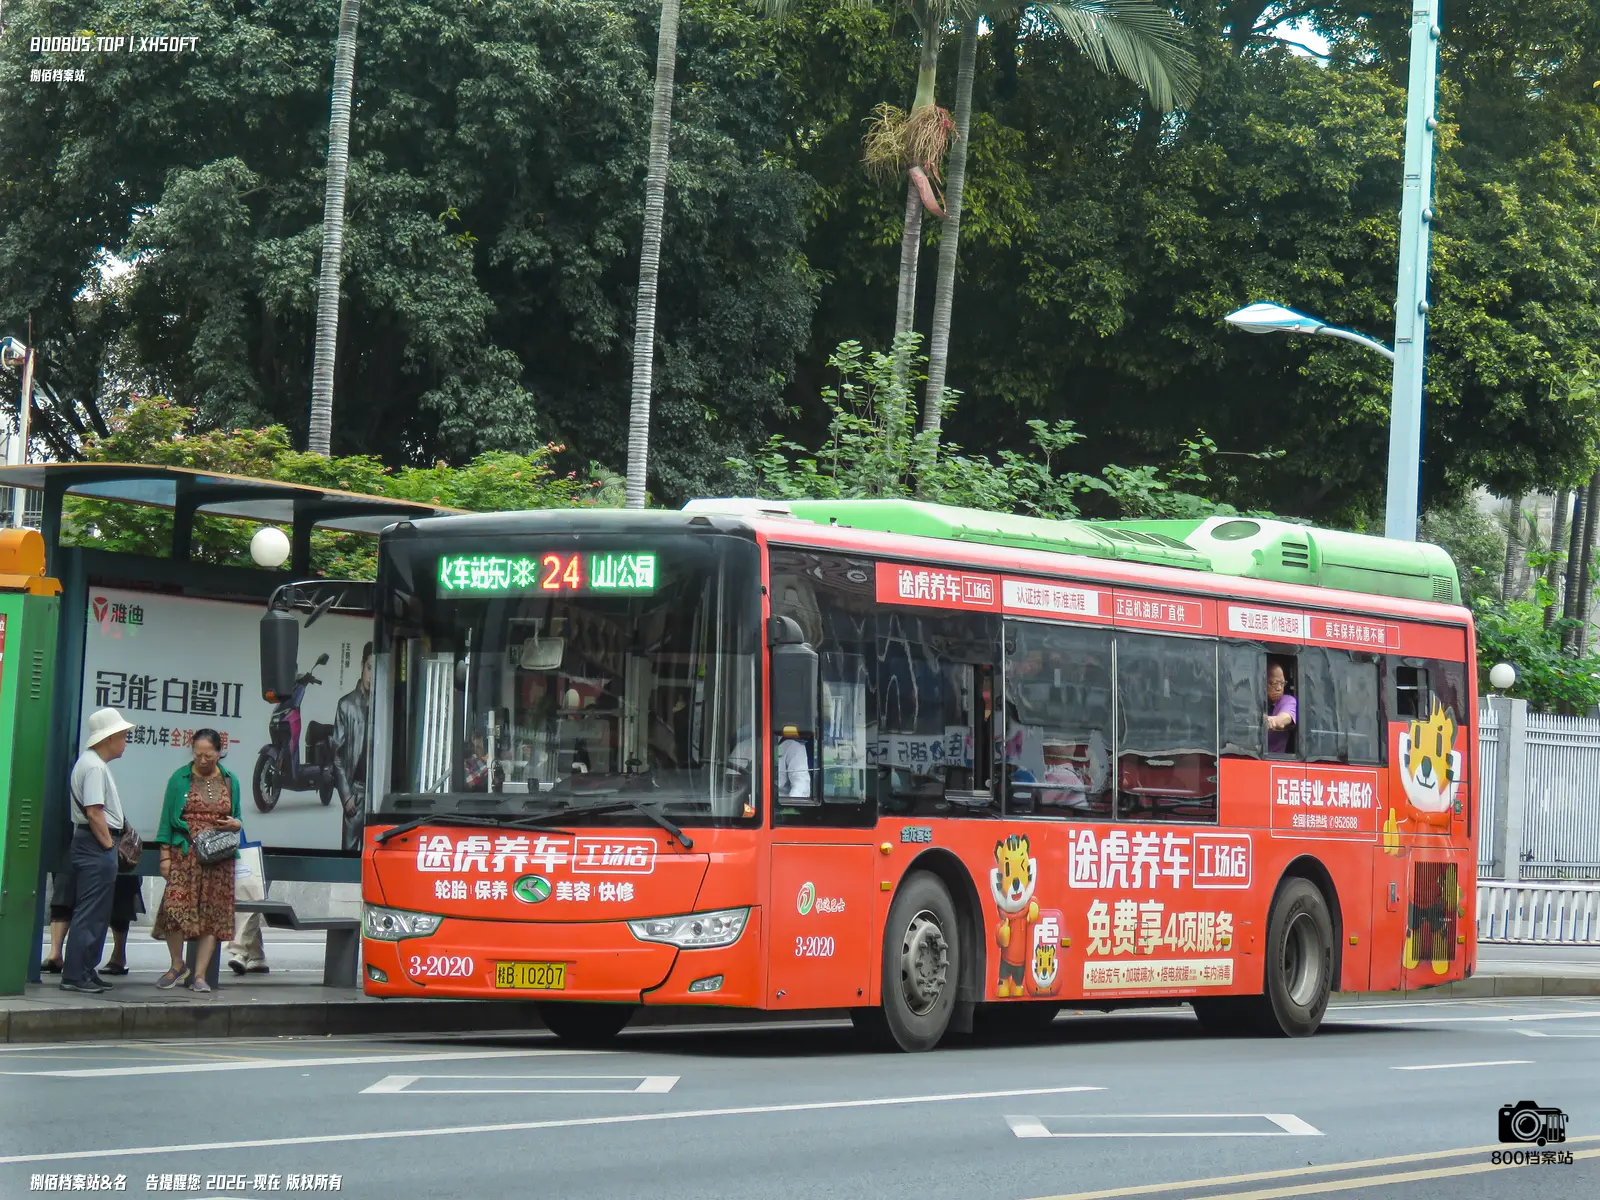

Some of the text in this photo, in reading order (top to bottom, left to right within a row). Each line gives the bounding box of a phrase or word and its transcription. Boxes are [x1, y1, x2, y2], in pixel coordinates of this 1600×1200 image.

[542, 553, 581, 589] 24
[898, 570, 991, 602] 途虎养车 工场店
[1016, 586, 1086, 611] 认证技师 标准流程
[1116, 598, 1186, 622] 正品机油原厂直供
[111, 603, 144, 625] 雅迪
[1240, 612, 1269, 631] 专业品质
[1325, 622, 1385, 644] 爱车保养优惠不断
[1277, 779, 1372, 808] 正品专业 大牌低价
[1334, 816, 1358, 828] 952688
[417, 836, 649, 873] 途虎养车 工场店
[1069, 830, 1246, 889] 途虎养车 工场店
[435, 881, 634, 901] 轮胎 保养 美容 快修
[1085, 899, 1234, 956] 免费享4项服务
[795, 936, 835, 957] 3-2020
[409, 956, 474, 977] 3-2020
[1090, 967, 1121, 984] 轮胎充气
[1126, 967, 1155, 982] 加玻璃水
[1161, 966, 1189, 981] 搭电救援
[1203, 965, 1231, 980] 车内消毒
